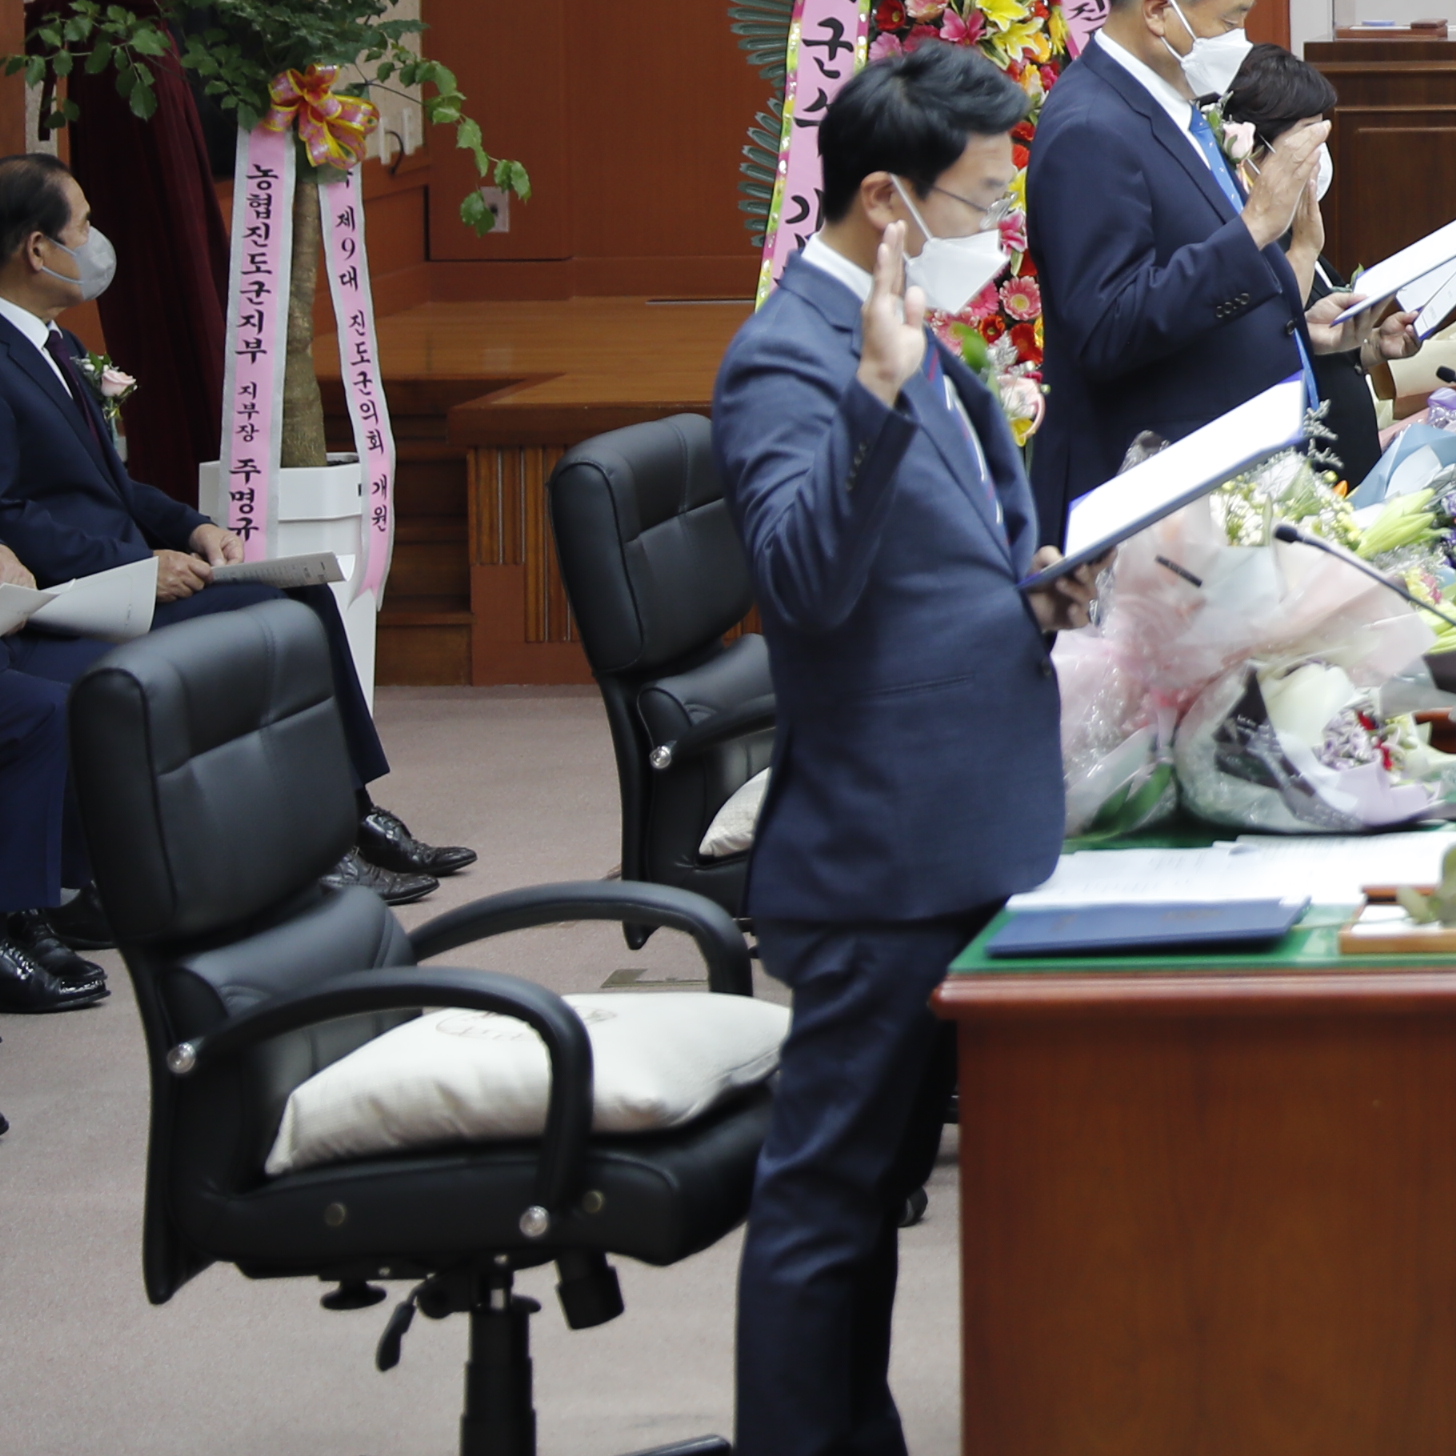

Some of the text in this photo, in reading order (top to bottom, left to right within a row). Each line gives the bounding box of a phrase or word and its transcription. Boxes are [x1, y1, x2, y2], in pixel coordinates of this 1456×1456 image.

[235, 164, 279, 365] 농협진도군지부
[235, 381, 260, 443] 지부장
[335, 205, 388, 532] 제9대 진도군의회 개원
